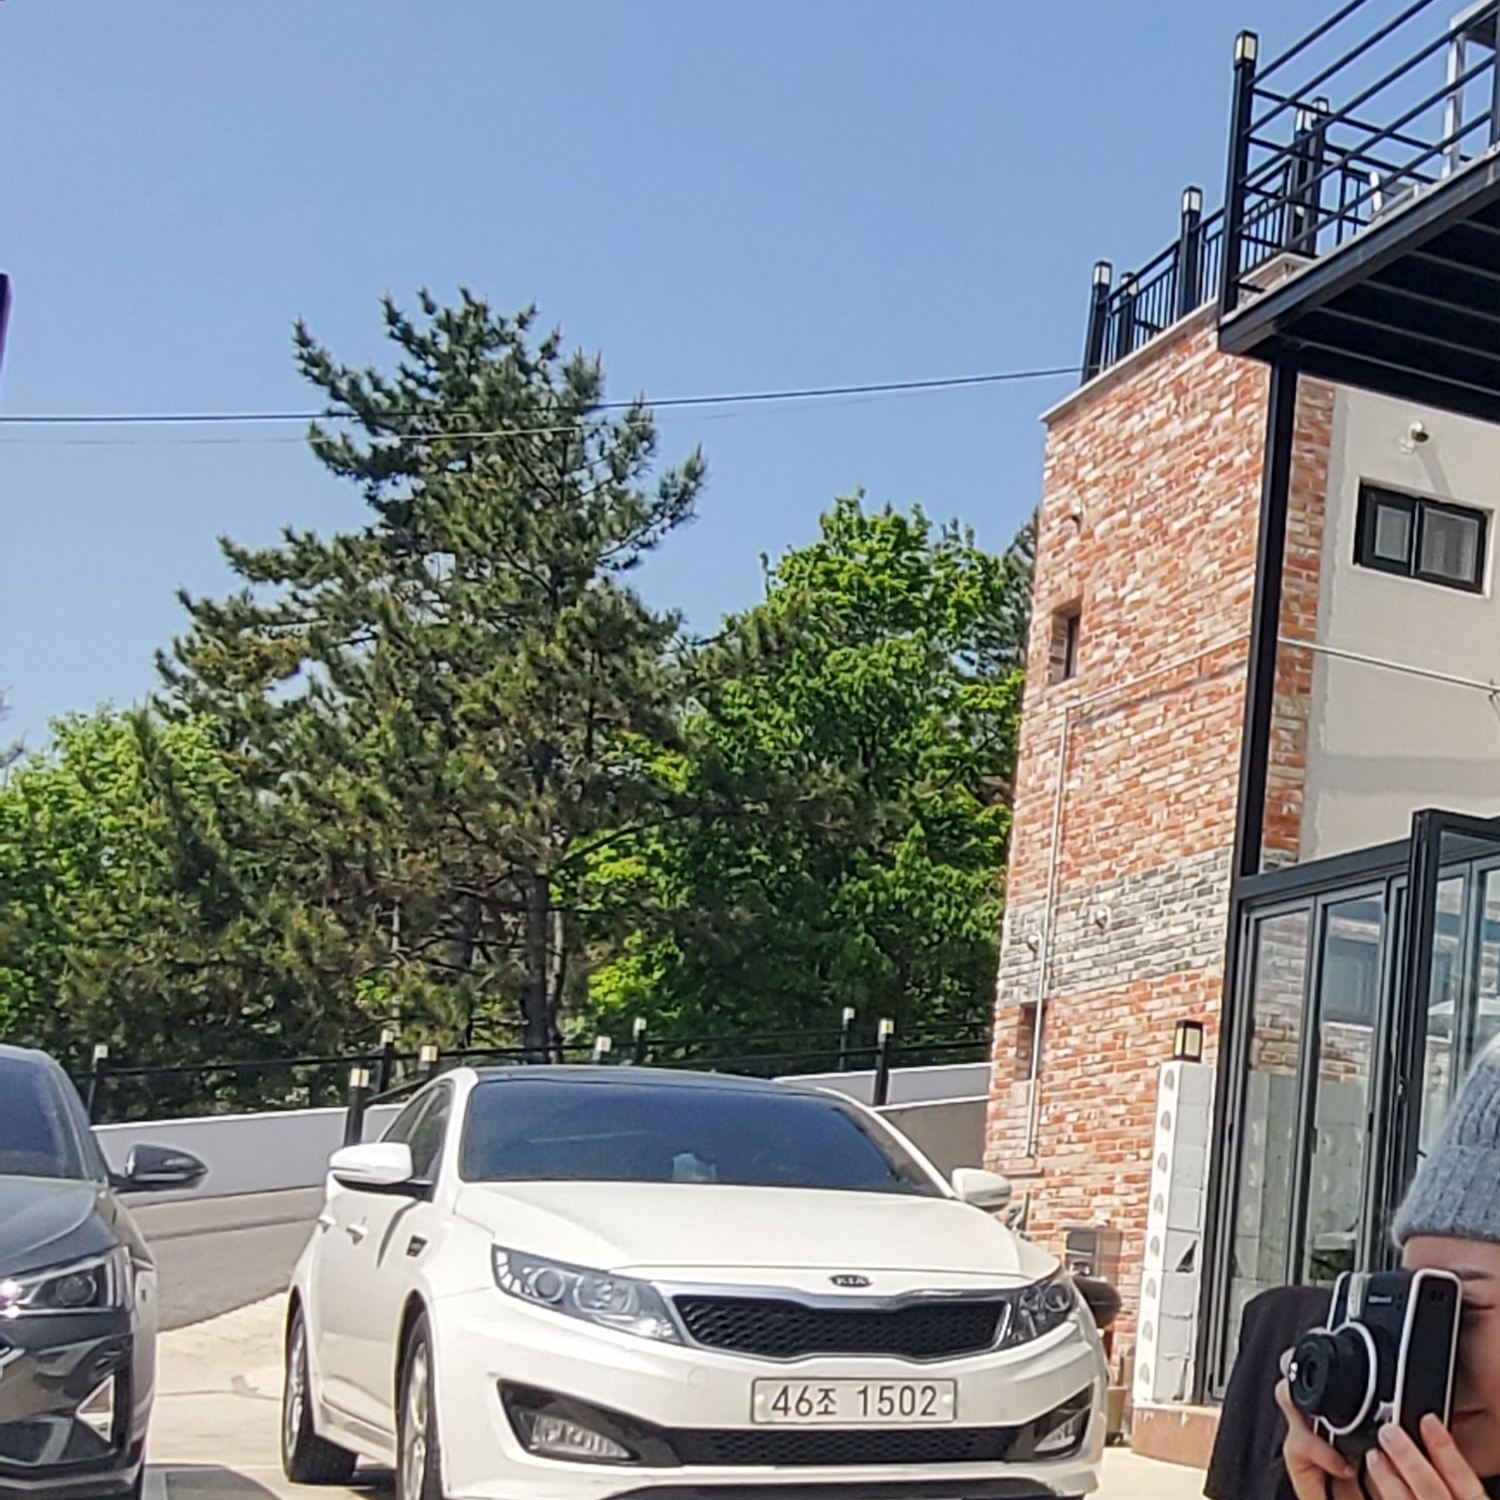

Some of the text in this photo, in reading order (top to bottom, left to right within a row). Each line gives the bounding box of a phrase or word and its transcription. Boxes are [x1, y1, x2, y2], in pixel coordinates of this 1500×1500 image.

[836, 1276, 867, 1285] KIA
[771, 1384, 937, 1417] 46조 1502
